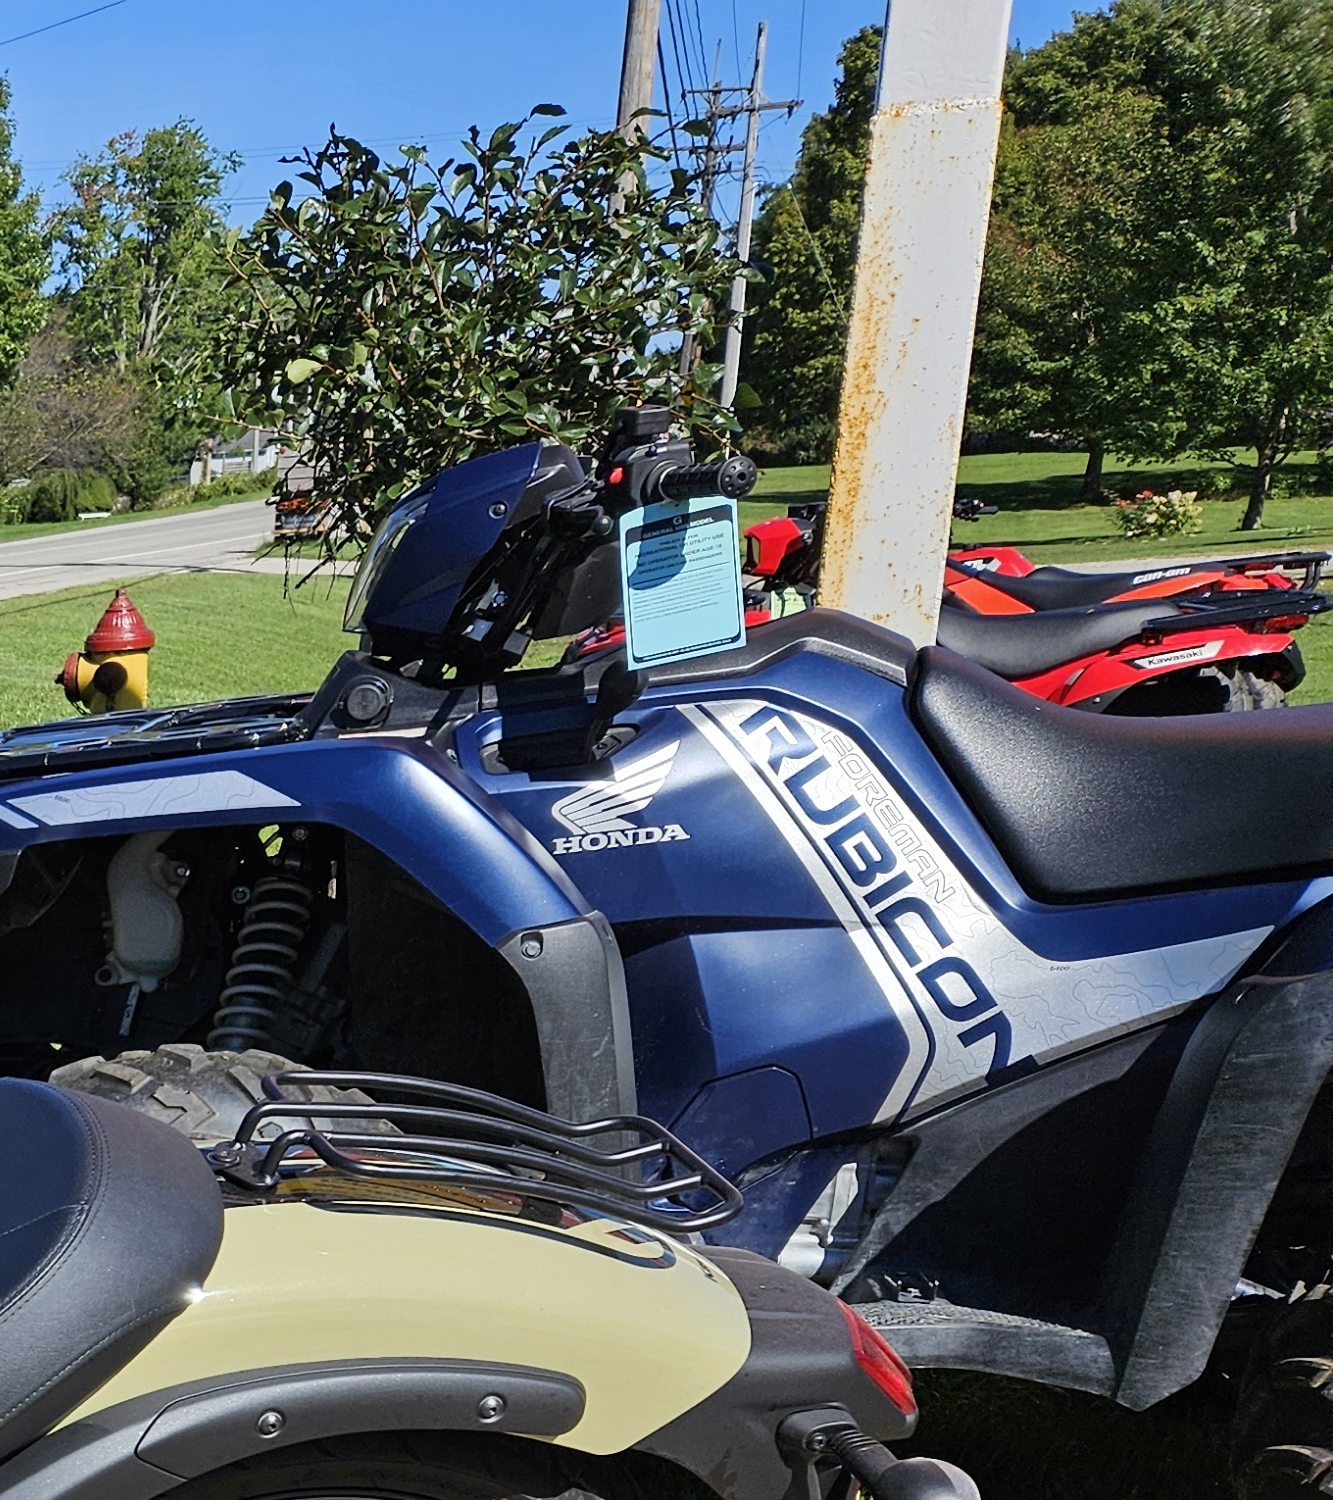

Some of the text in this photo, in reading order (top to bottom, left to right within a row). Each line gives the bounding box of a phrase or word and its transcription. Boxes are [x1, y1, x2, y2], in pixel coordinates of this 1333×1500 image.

[689, 516, 715, 527] MODEL
[1147, 650, 1203, 666] Kawasaki
[820, 730, 958, 905] FOREMAN
[552, 823, 691, 855] HONDA
[738, 705, 1037, 1088] RUBICON
